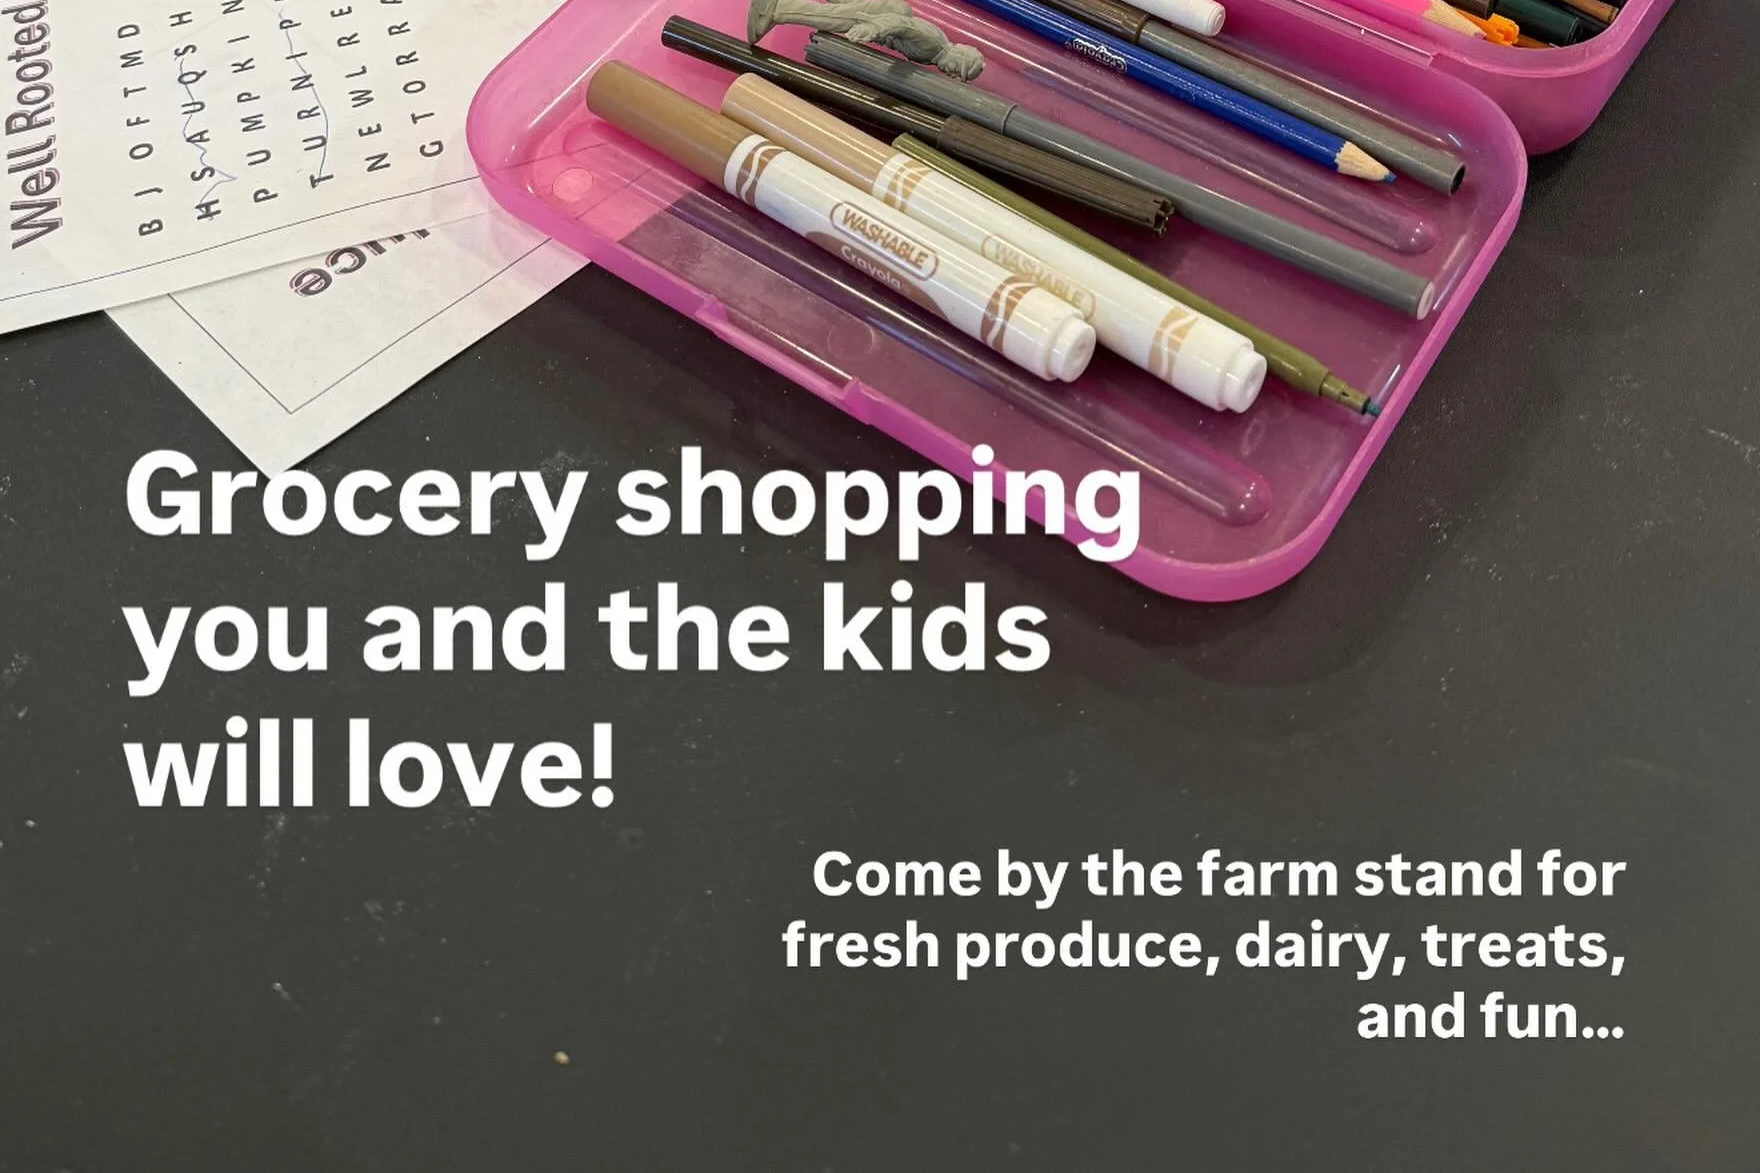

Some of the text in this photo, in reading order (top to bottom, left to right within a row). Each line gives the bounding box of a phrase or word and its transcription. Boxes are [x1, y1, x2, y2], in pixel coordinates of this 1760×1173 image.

[1, 0, 55, 136] Rooted
[1072, 39, 1128, 74] Crayola
[6, 134, 63, 251] Well
[841, 245, 902, 289] Crayola
[842, 209, 929, 270] WASHABLE
[994, 241, 1086, 306] WASHABLE
